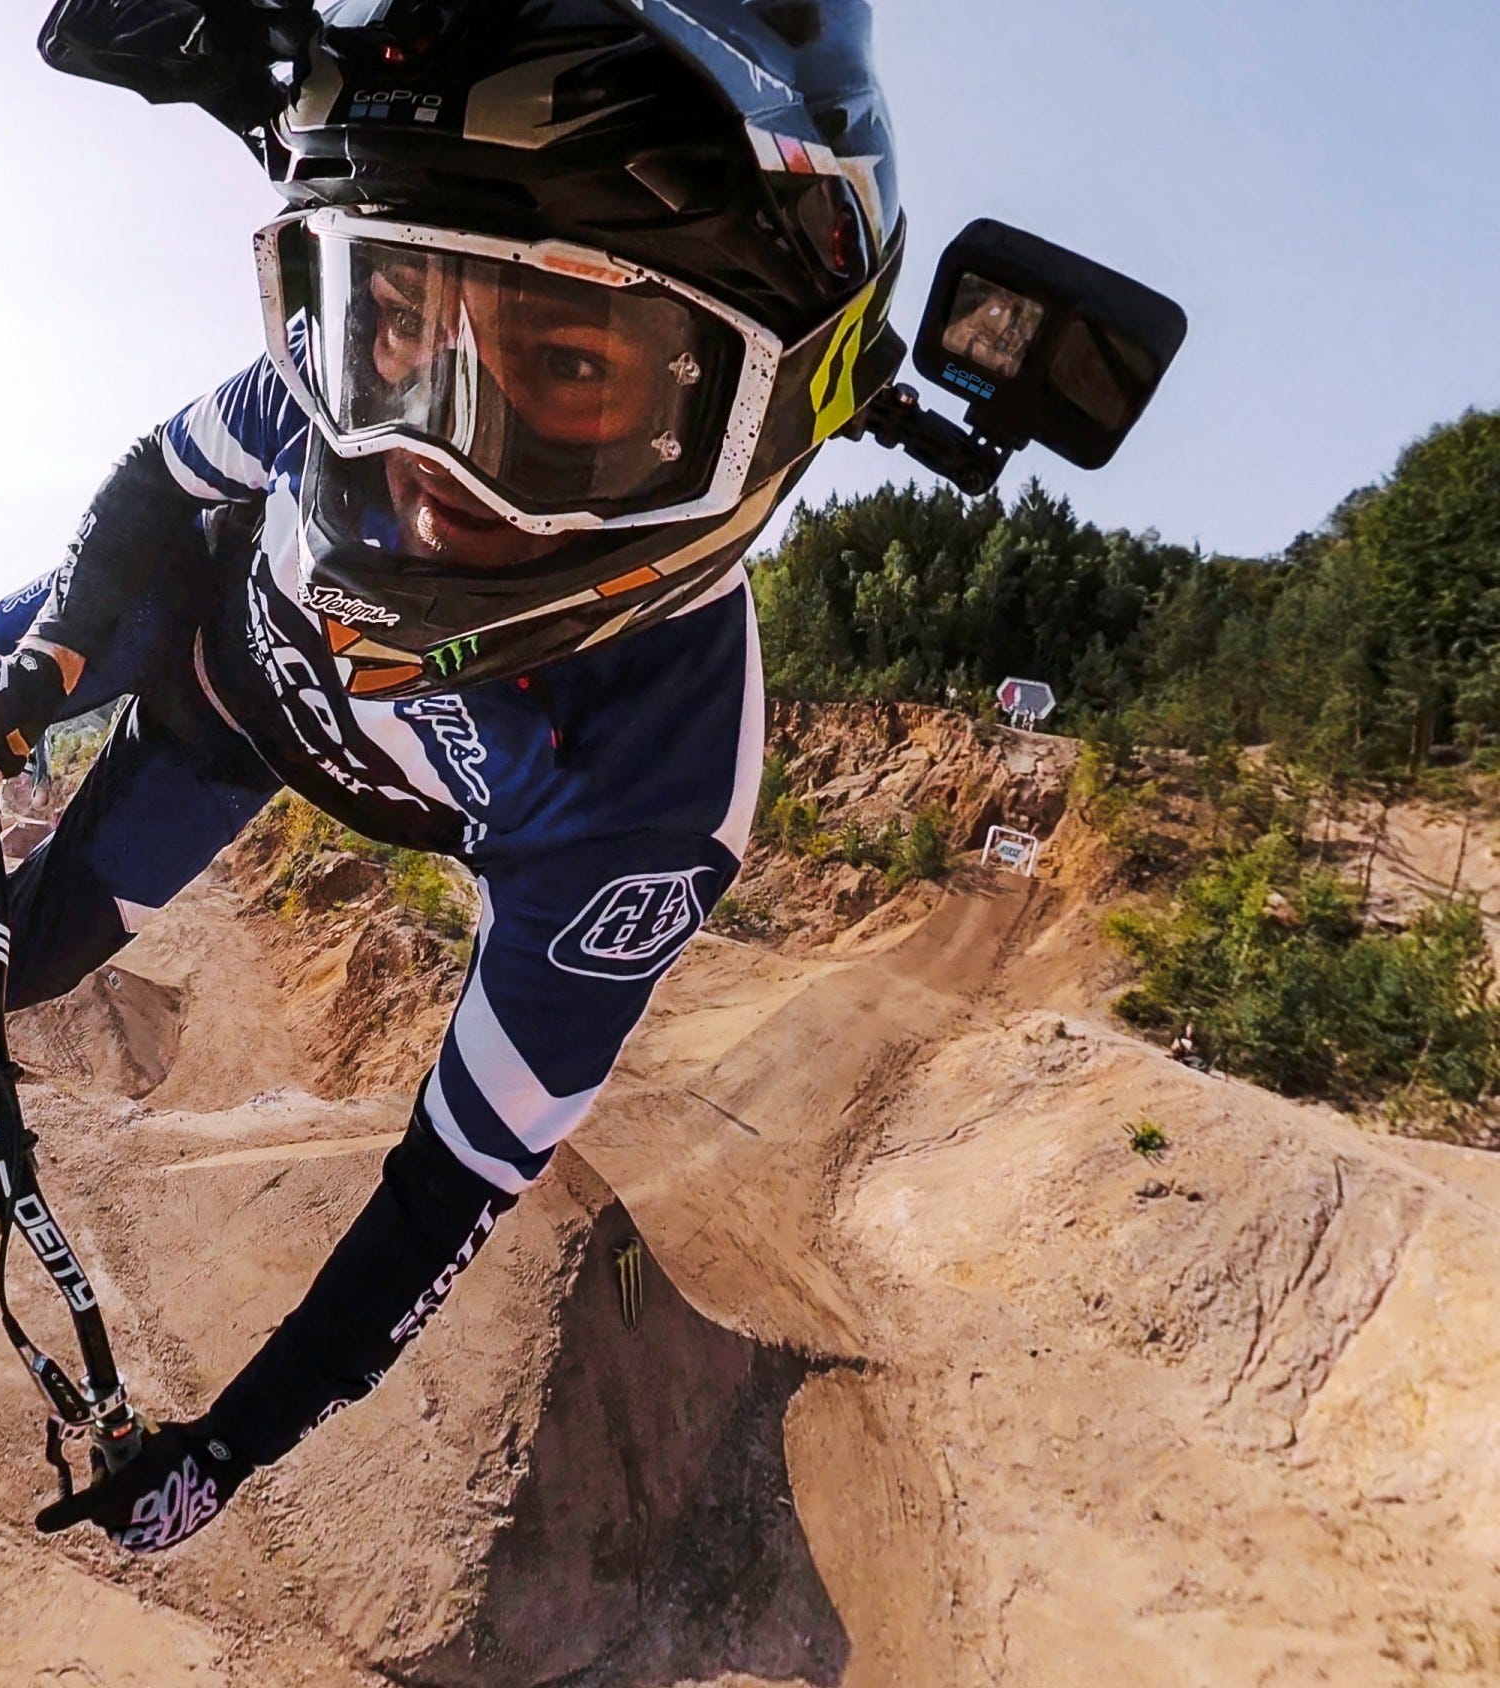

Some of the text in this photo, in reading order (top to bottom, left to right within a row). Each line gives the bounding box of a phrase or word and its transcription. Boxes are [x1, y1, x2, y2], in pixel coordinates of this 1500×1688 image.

[353, 88, 443, 107] GoPro
[945, 361, 996, 393] GoPro
[14, 1193, 97, 1311] DEITY
